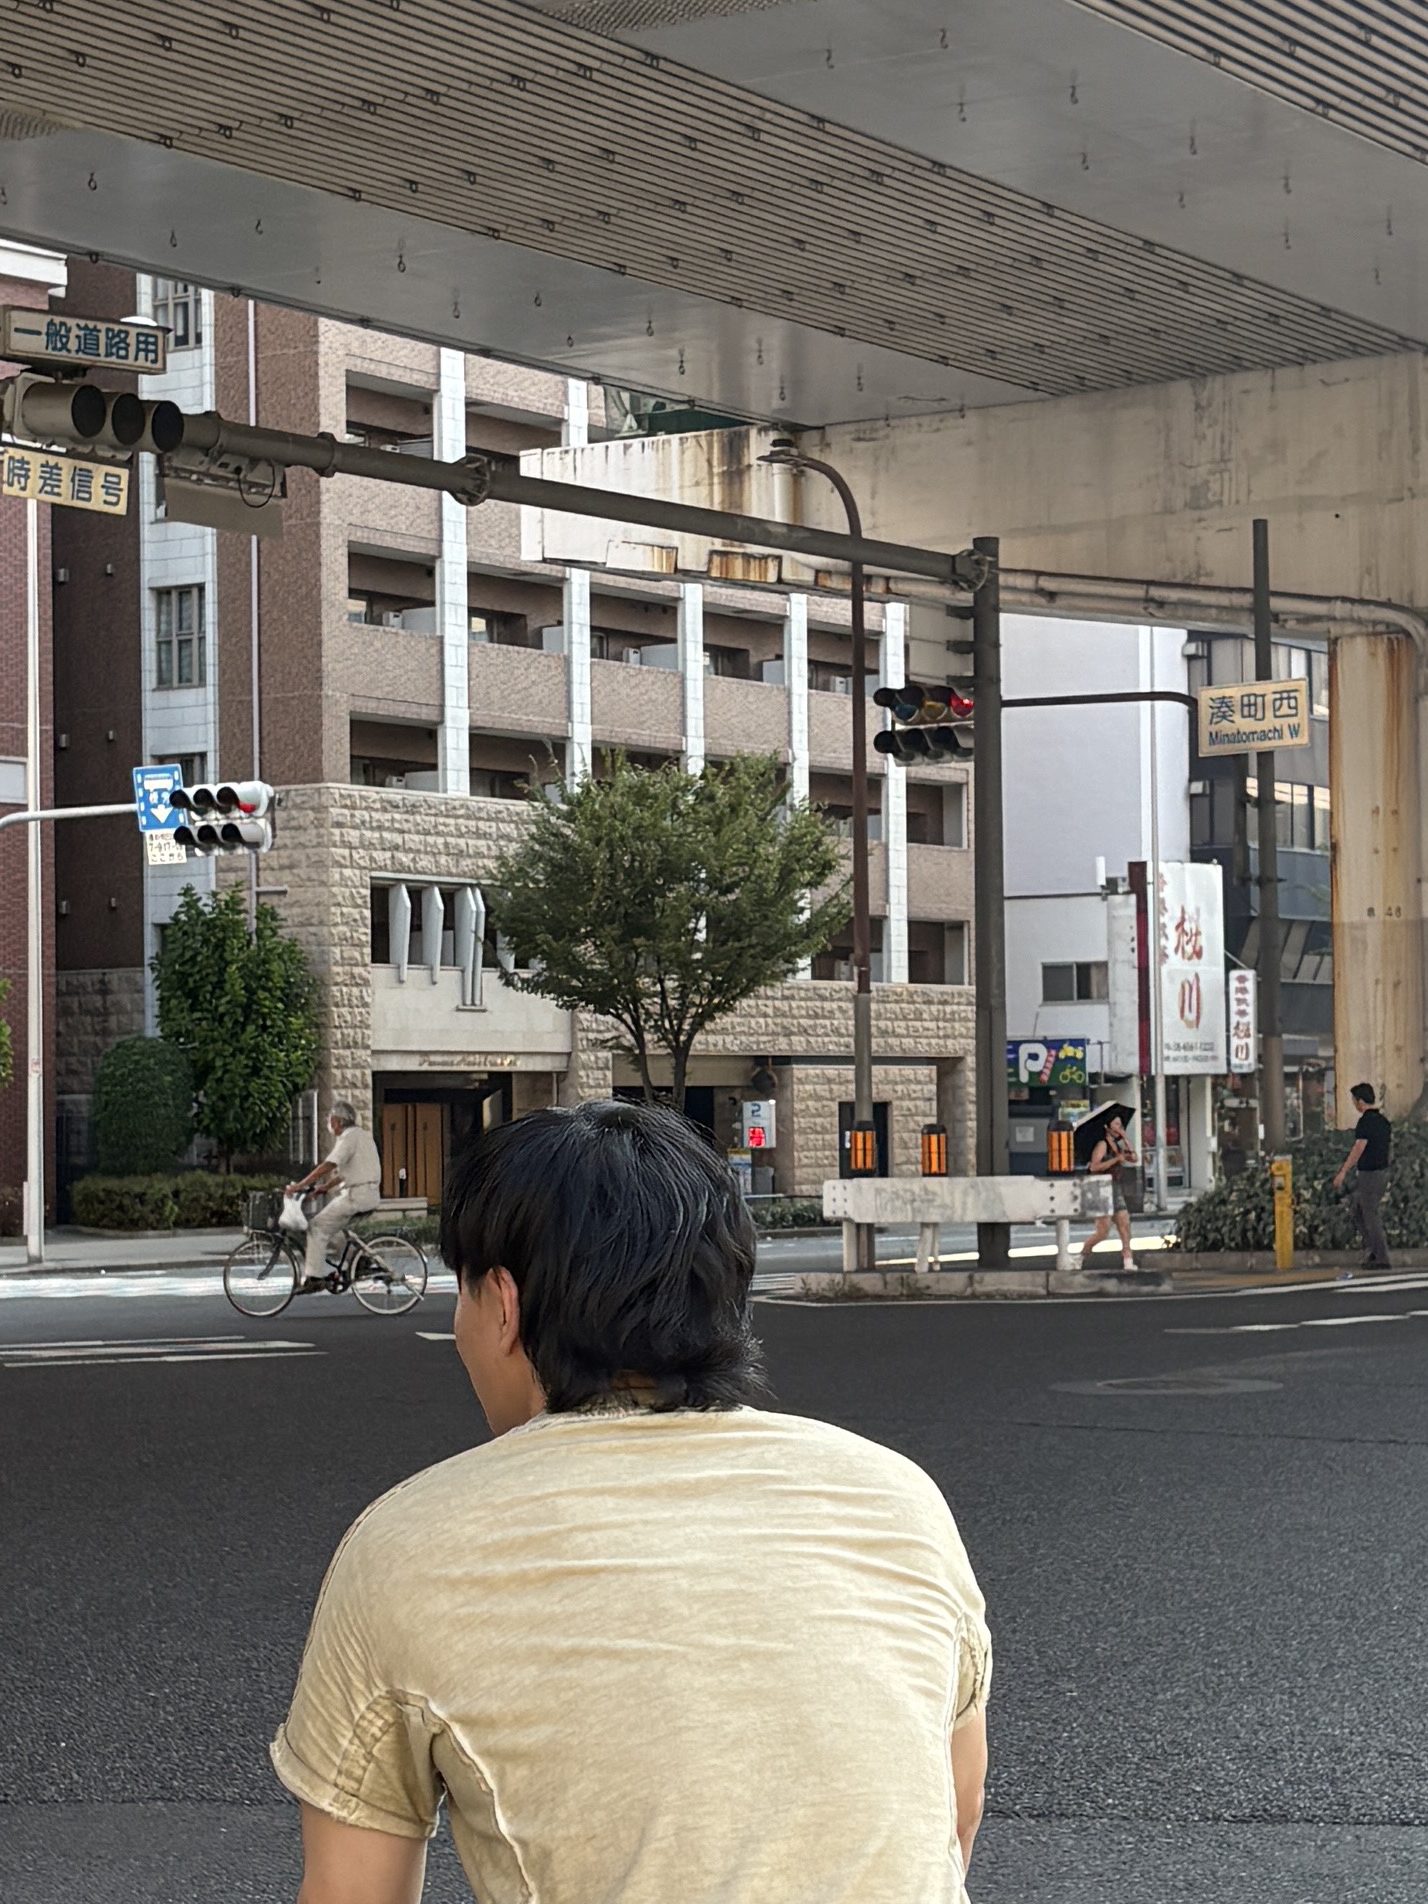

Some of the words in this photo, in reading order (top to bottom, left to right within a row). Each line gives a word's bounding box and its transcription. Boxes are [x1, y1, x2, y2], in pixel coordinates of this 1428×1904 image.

[13, 318, 159, 364] 一般道路用
[6, 455, 123, 506] 時差信号
[1208, 689, 1300, 725] 湊町西
[1208, 725, 1284, 746] Minatomachi
[1288, 722, 1301, 740] W
